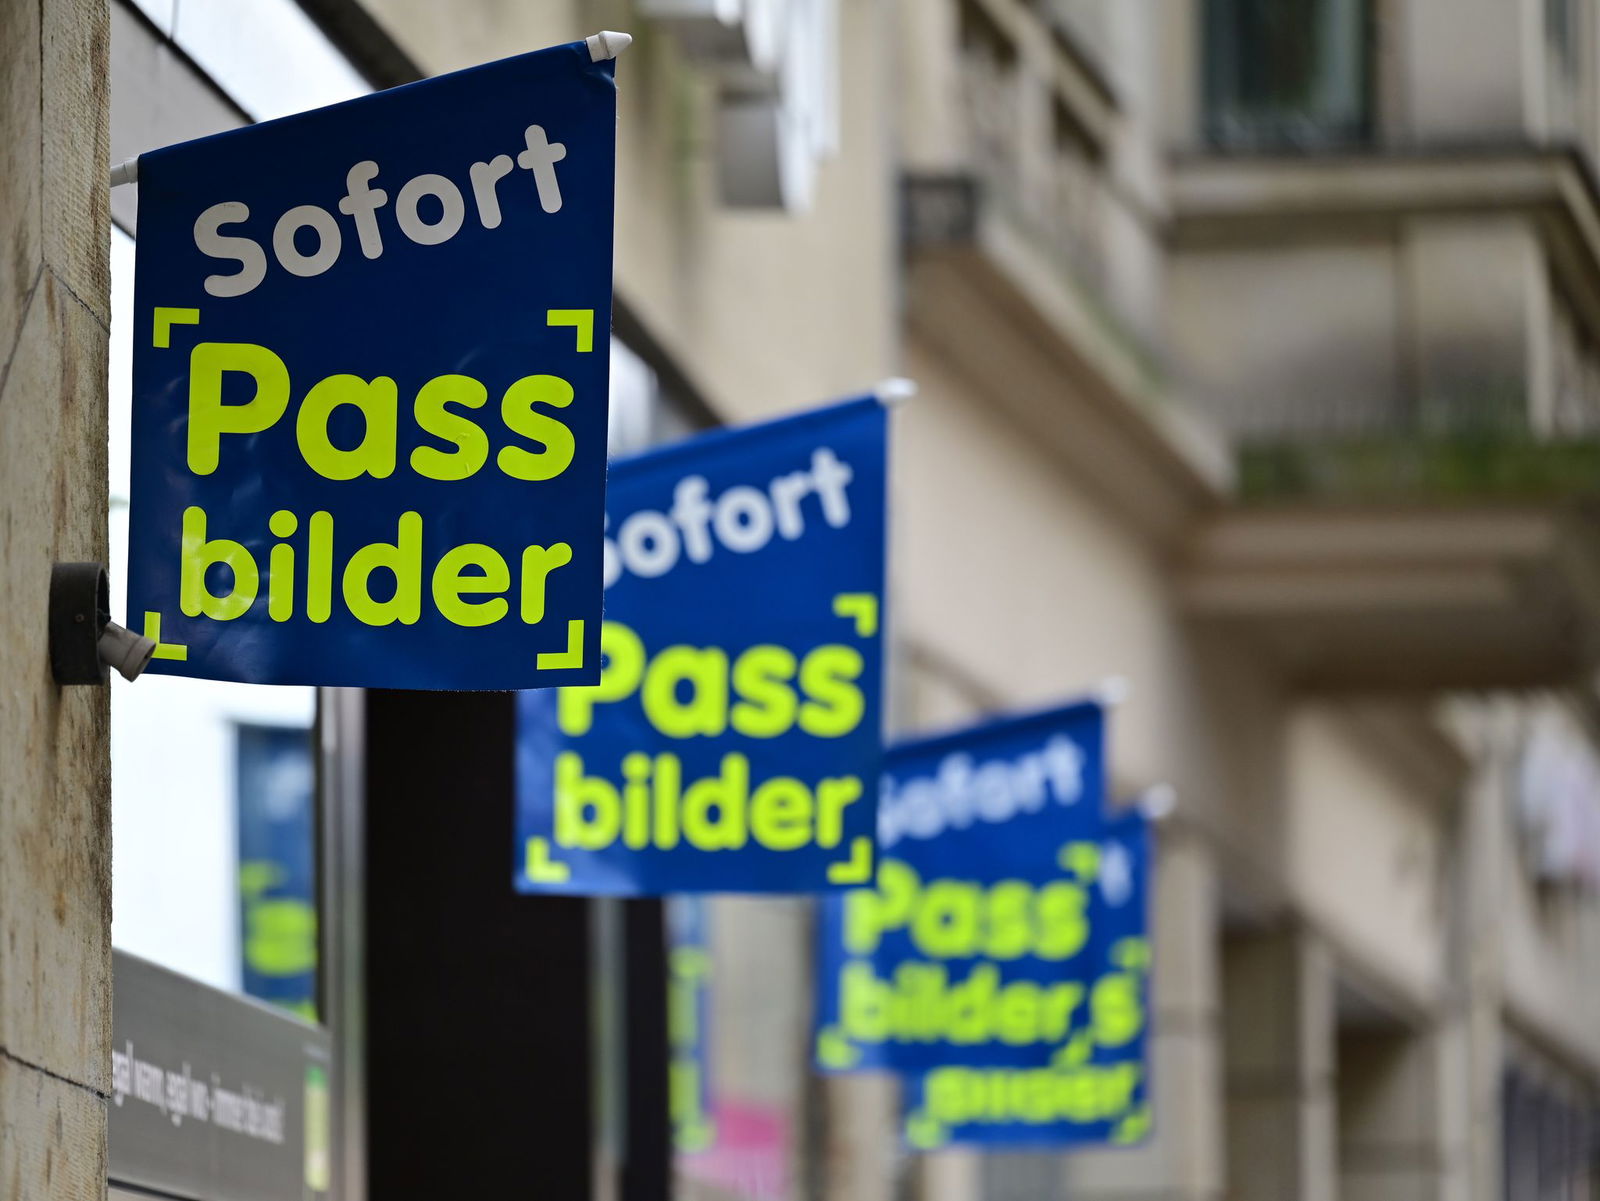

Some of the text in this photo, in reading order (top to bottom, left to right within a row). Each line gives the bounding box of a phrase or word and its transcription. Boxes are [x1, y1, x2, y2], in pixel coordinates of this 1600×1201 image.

[193, 124, 567, 298] Sofort
[187, 341, 576, 482] Pass
[179, 506, 573, 627] bilder
[555, 620, 866, 739] Pass
[553, 751, 864, 852] bilder
[839, 960, 1084, 1045] bilder
